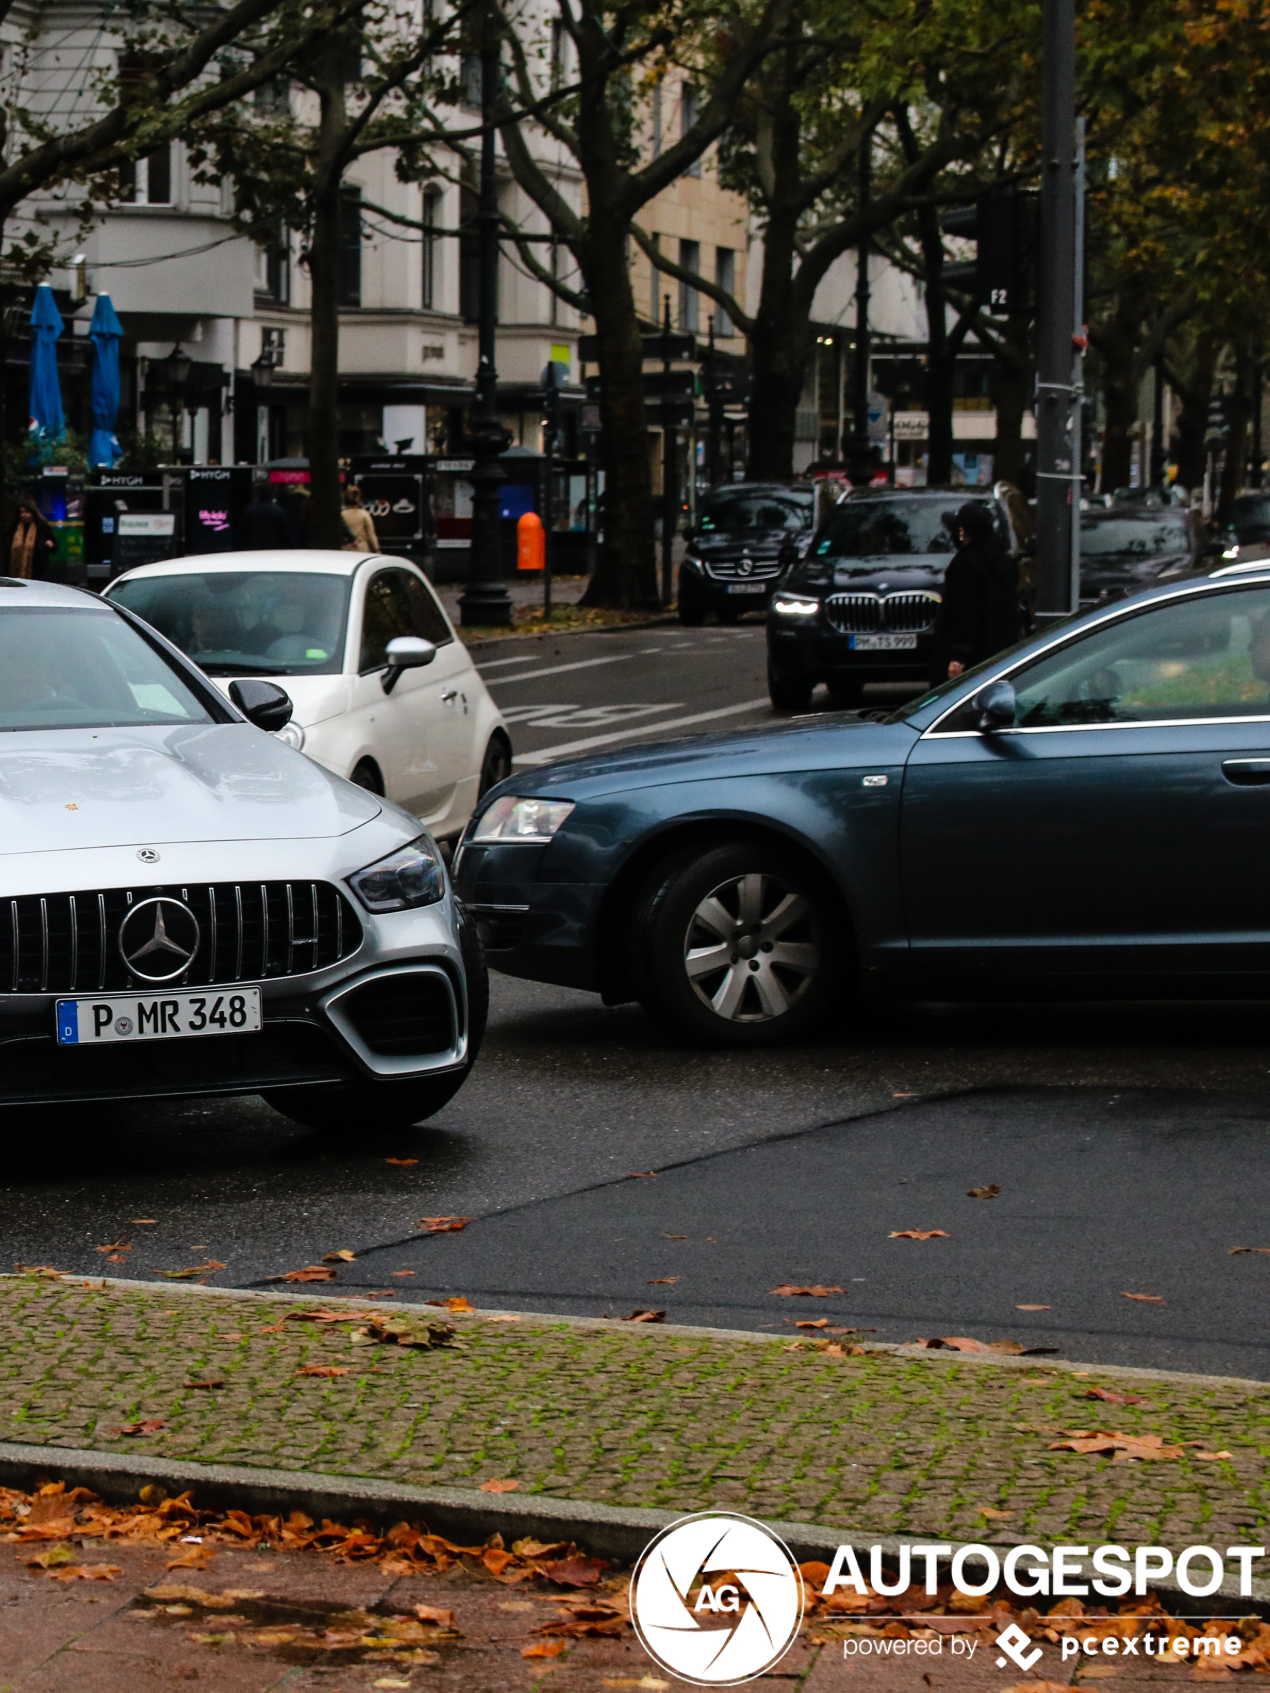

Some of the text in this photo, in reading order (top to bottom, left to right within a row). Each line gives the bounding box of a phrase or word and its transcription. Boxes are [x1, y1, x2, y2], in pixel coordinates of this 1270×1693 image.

[991, 288, 1008, 304] F2
[92, 995, 247, 1037] P MR 348
[64, 1026, 73, 1037] D
